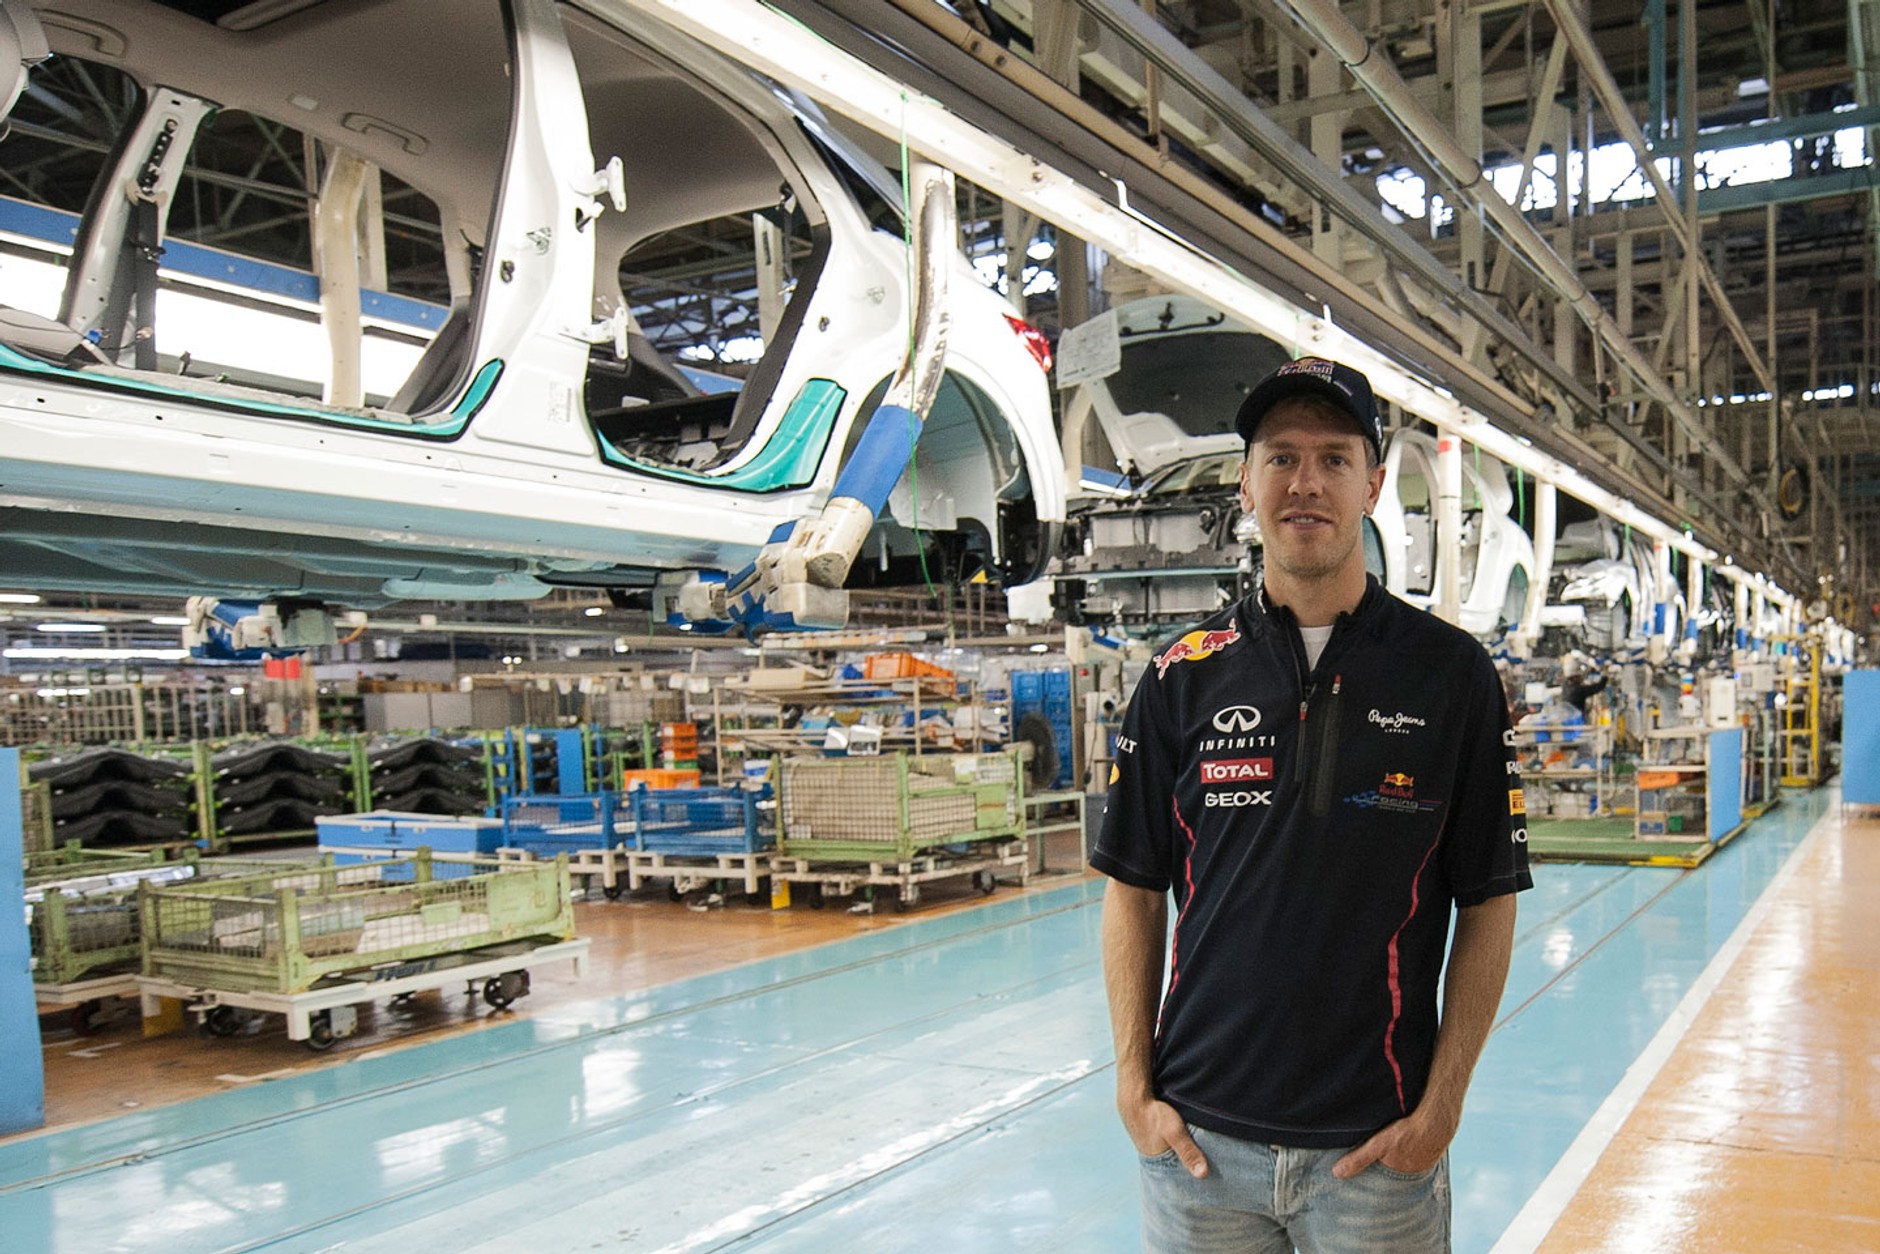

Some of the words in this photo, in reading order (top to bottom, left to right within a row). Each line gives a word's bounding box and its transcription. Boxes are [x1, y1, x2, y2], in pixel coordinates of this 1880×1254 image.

[1394, 712, 1426, 728] Jeans
[1199, 736, 1275, 752] INFINITI
[1205, 790, 1273, 808] GEOX
